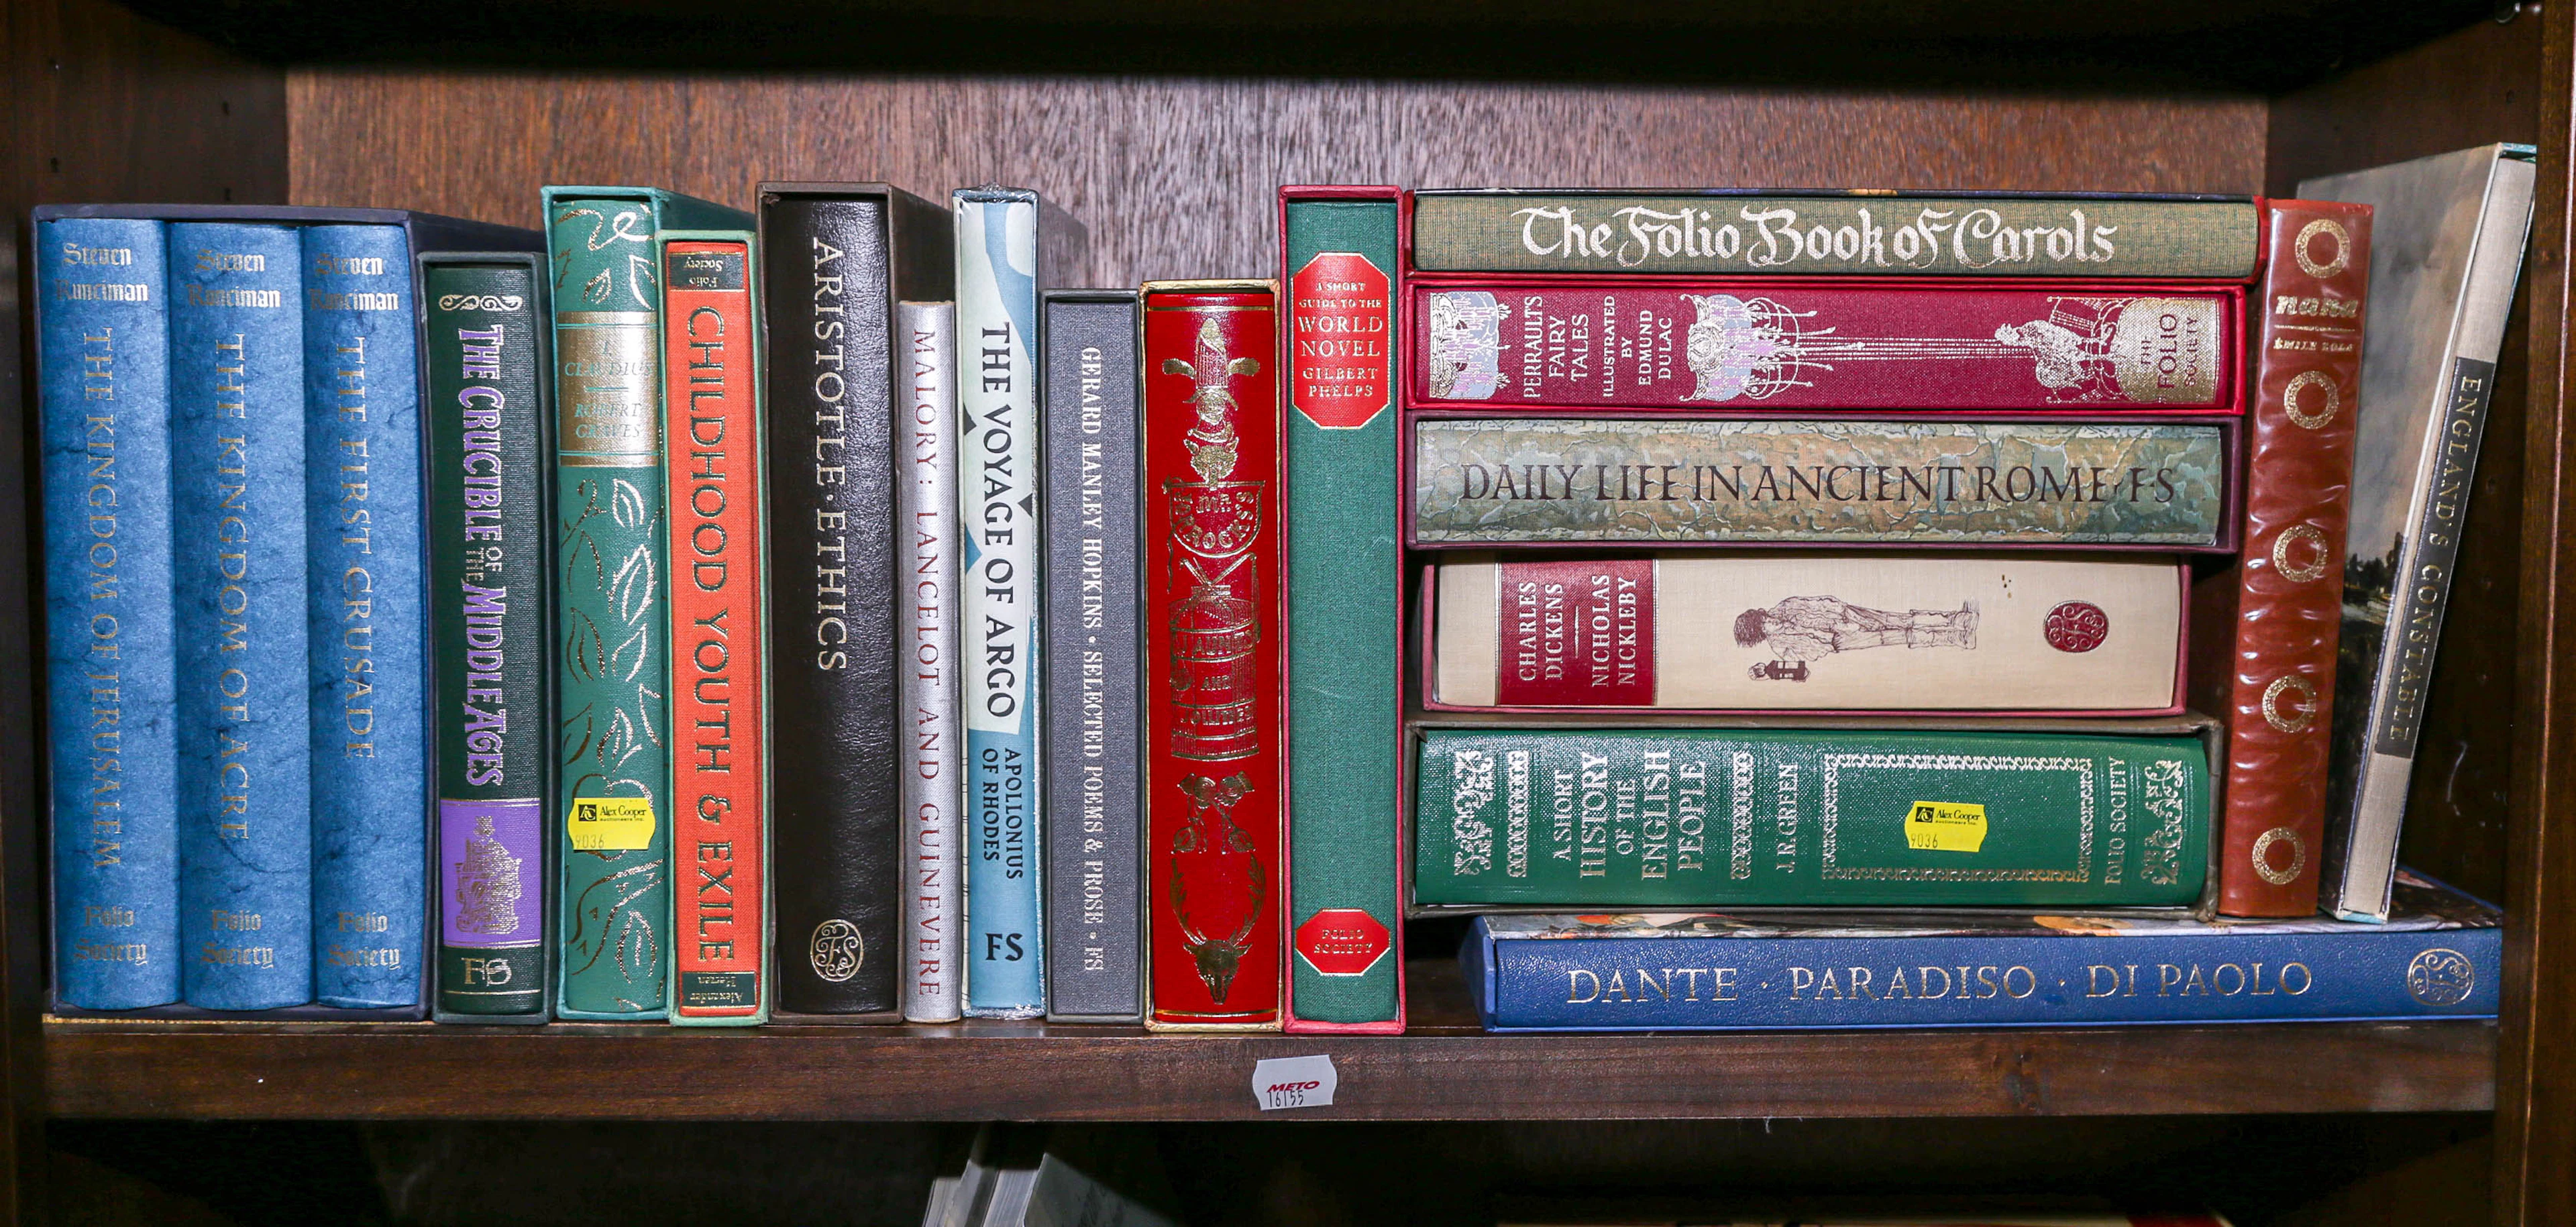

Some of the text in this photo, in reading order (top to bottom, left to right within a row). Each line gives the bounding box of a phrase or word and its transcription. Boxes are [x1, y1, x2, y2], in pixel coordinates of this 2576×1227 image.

[62, 242, 131, 268] Steven
[1511, 205, 1613, 258] The
[1613, 205, 1740, 266] Folio
[1740, 205, 1892, 268] Book
[1953, 208, 2118, 269] Carols
[195, 248, 265, 272] Steven
[315, 252, 383, 276] Steven
[683, 256, 723, 272] Society
[56, 279, 148, 302] Runciman
[188, 284, 280, 308] Runciman
[309, 288, 398, 311] Runciman
[689, 277, 718, 287] Folio
[1299, 299, 1382, 307] GUIDE TO THE
[1316, 282, 1366, 291] A SHORT
[1298, 316, 1383, 333] WORLD
[458, 324, 503, 380] THE
[1301, 340, 1380, 357] NOVEL
[1548, 316, 1566, 378] FAIRY
[1570, 313, 1589, 382] TALES
[1603, 296, 1616, 397] ILLUSTRATED
[1621, 337, 1633, 358] BY
[1639, 310, 1653, 386] EDMUND
[1658, 317, 1672, 380] DULAC
[2157, 313, 2178, 388] FOLIO
[2184, 317, 2198, 386] SOCIETY
[1303, 368, 1378, 380] GILBERT
[1308, 385, 1374, 397] PHELPS
[1461, 464, 1583, 500] DAILY
[1595, 464, 1680, 500] LIFE
[1693, 465, 1745, 502] IN
[1751, 465, 1966, 502] ANCIENT
[982, 322, 1016, 718] THE VOYAGE OF ARGO
[335, 336, 374, 759] THE FIRST CRUSADE
[467, 547, 484, 582] THE
[485, 546, 503, 572] OF
[2390, 374, 2482, 741] ENGLAND'S CONSTABLE
[83, 327, 121, 869] THE KINGDOM OF JERUSALEM
[215, 333, 250, 839] THE KINGDOM OF ACRE
[914, 511, 941, 686] LANCELOT
[461, 577, 506, 703] MIDDLE
[687, 306, 733, 961] CHILDHOOD YOUTH & EXILE
[1519, 582, 1536, 682] CHARLES
[1545, 583, 1563, 681] DICKENS
[1591, 574, 1609, 687] NICHOLAS
[1618, 576, 1637, 686] NICKLEBY
[1081, 347, 1104, 971] GERARD MANLEY HOPKINS SELECTED POEMS & PROSE FS
[462, 701, 506, 786] AGES
[918, 707, 940, 780] AND
[600, 805, 646, 818] Alex Cooper
[982, 748, 1000, 861] OF RHODES
[1005, 747, 1023, 879] APOLLONIUS
[1553, 769, 1573, 861] A SHORT
[1580, 750, 1608, 877] HISTORY
[1615, 780, 1635, 855] OF THE
[1642, 750, 1670, 880] ENGLISH
[1677, 761, 1706, 871] PEOPLE
[1778, 761, 1799, 835] GREEN
[1936, 810, 1981, 822] Alex Cooper
[576, 834, 604, 849] 9036
[1911, 834, 1938, 848] 9036
[2105, 755, 2127, 885] FOLIO SOCIETY
[84, 906, 134, 928] Folio
[211, 909, 262, 931] Folio
[918, 802, 941, 996] GUINEVERE
[337, 912, 387, 932] Folio
[1322, 929, 1364, 939] FOLIO
[74, 939, 147, 965] Society
[201, 942, 273, 969] Society
[327, 944, 400, 970] Society
[985, 932, 1024, 961] FS
[1313, 943, 1373, 954] SOCIETY
[690, 992, 743, 1004] Alexander
[1566, 961, 2312, 1004] DANTE PARADISO DI PAOLO
[1267, 1081, 1320, 1093] METO
[1269, 1089, 1303, 1108] 16155
